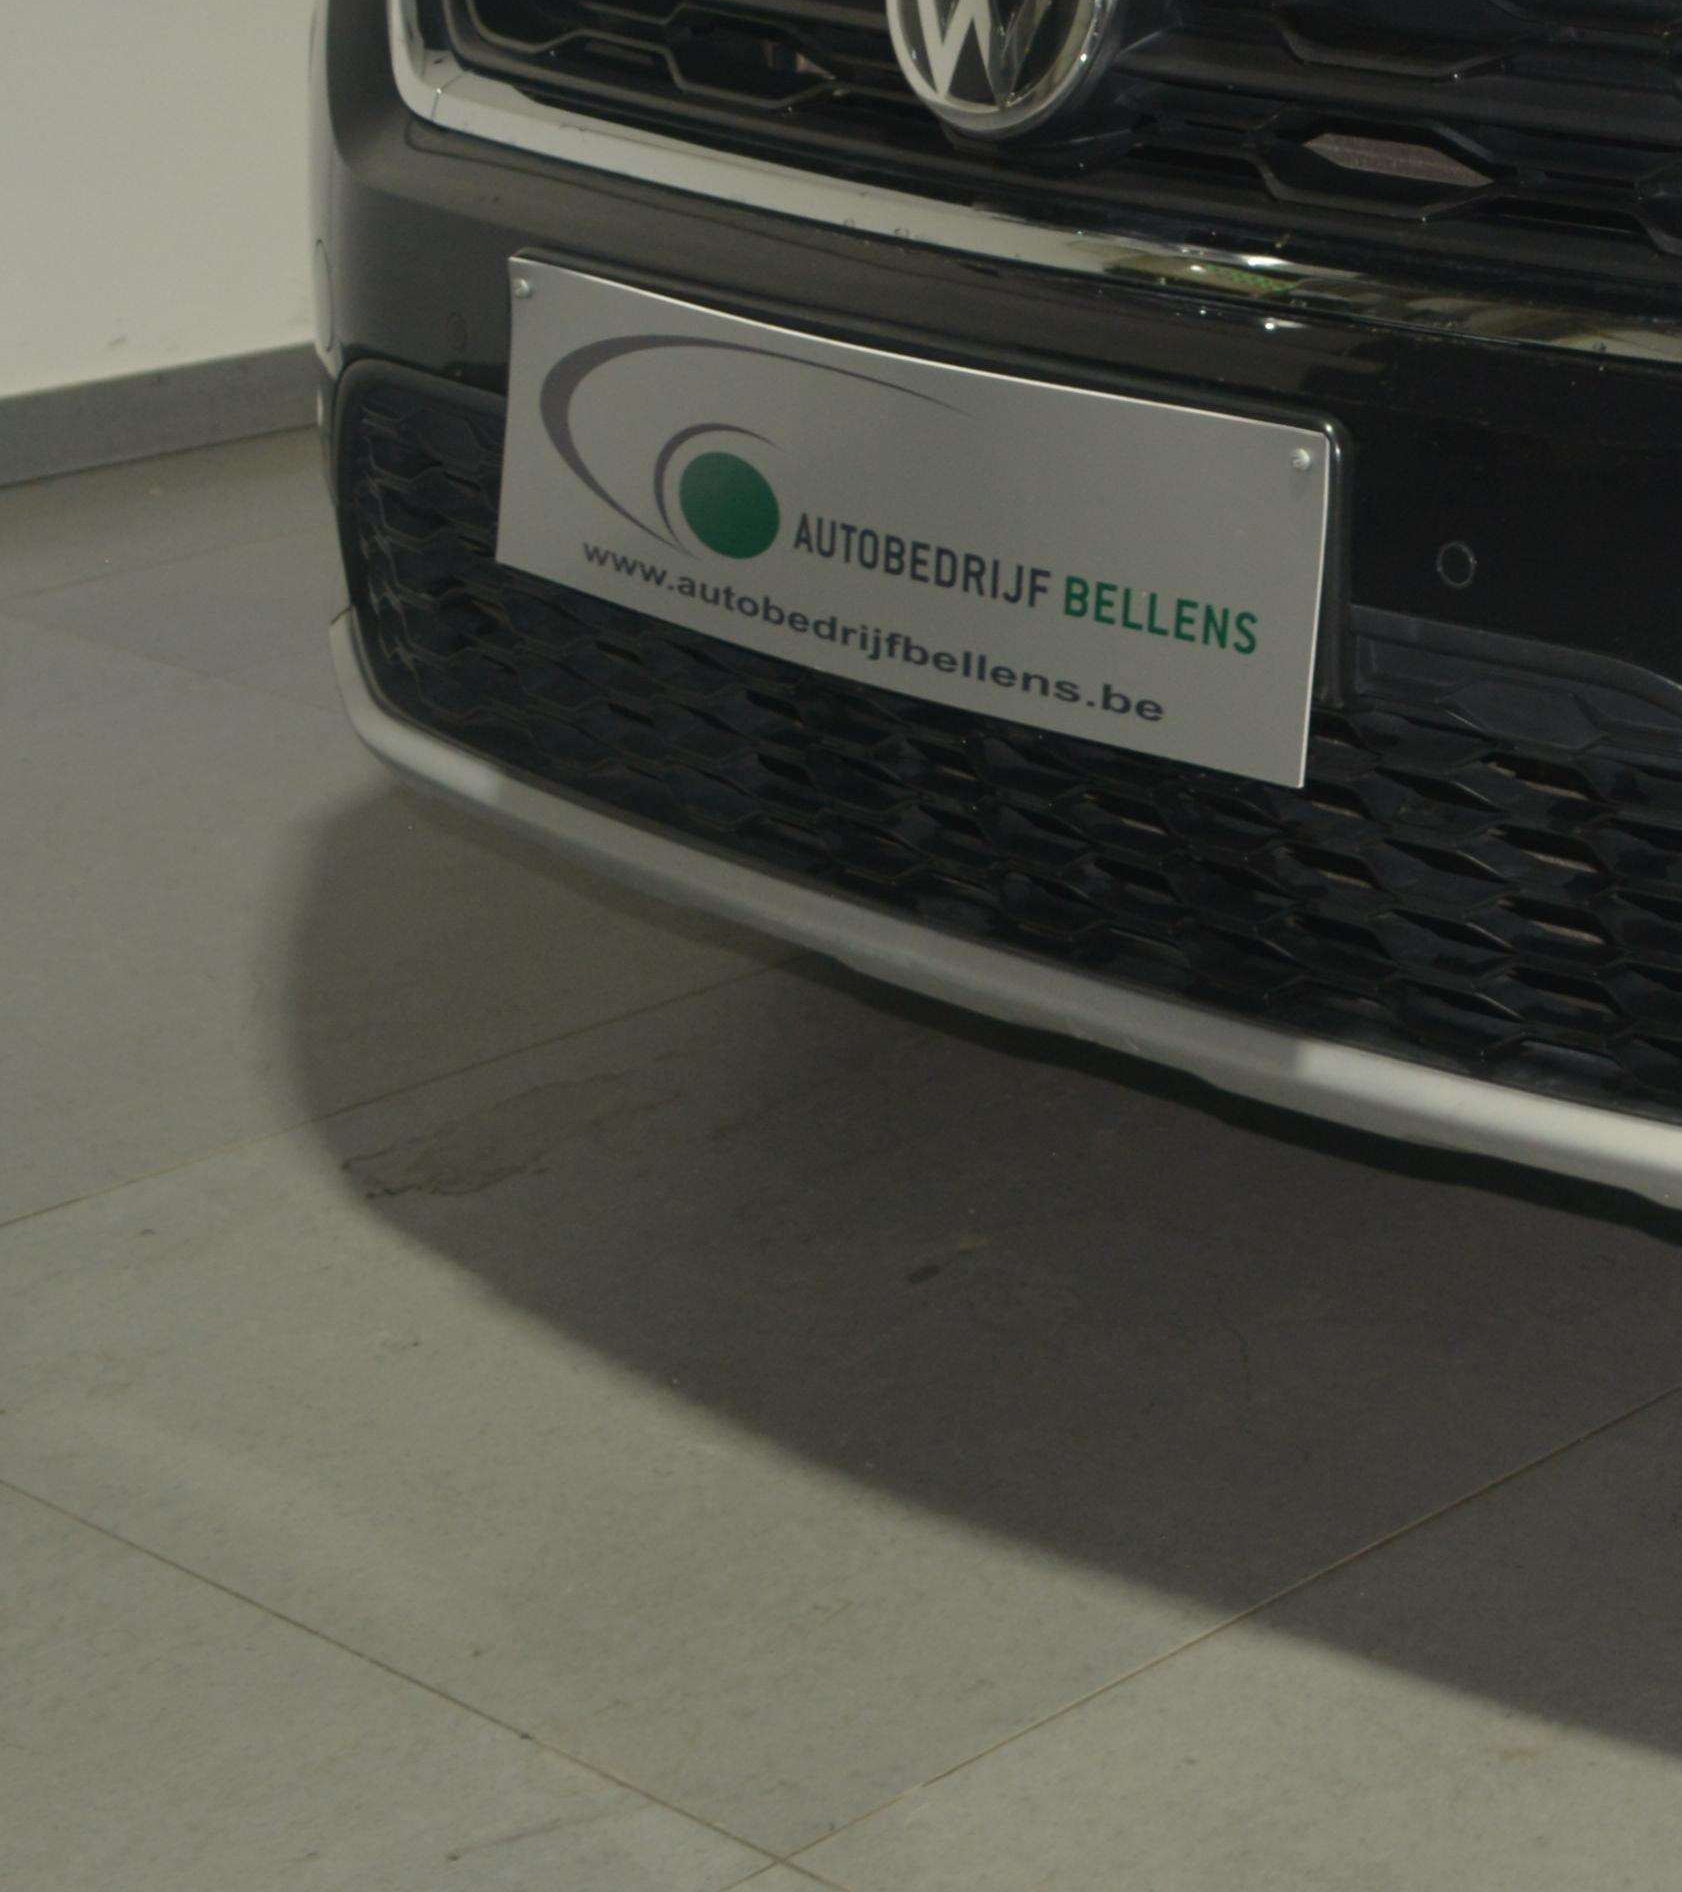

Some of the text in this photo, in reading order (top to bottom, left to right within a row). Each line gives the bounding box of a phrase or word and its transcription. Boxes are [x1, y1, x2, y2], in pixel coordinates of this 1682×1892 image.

[582, 539, 1166, 725] www.autobedrijfbellens.be
[793, 511, 1261, 657] AUTOBEDRIJF BELLENS
